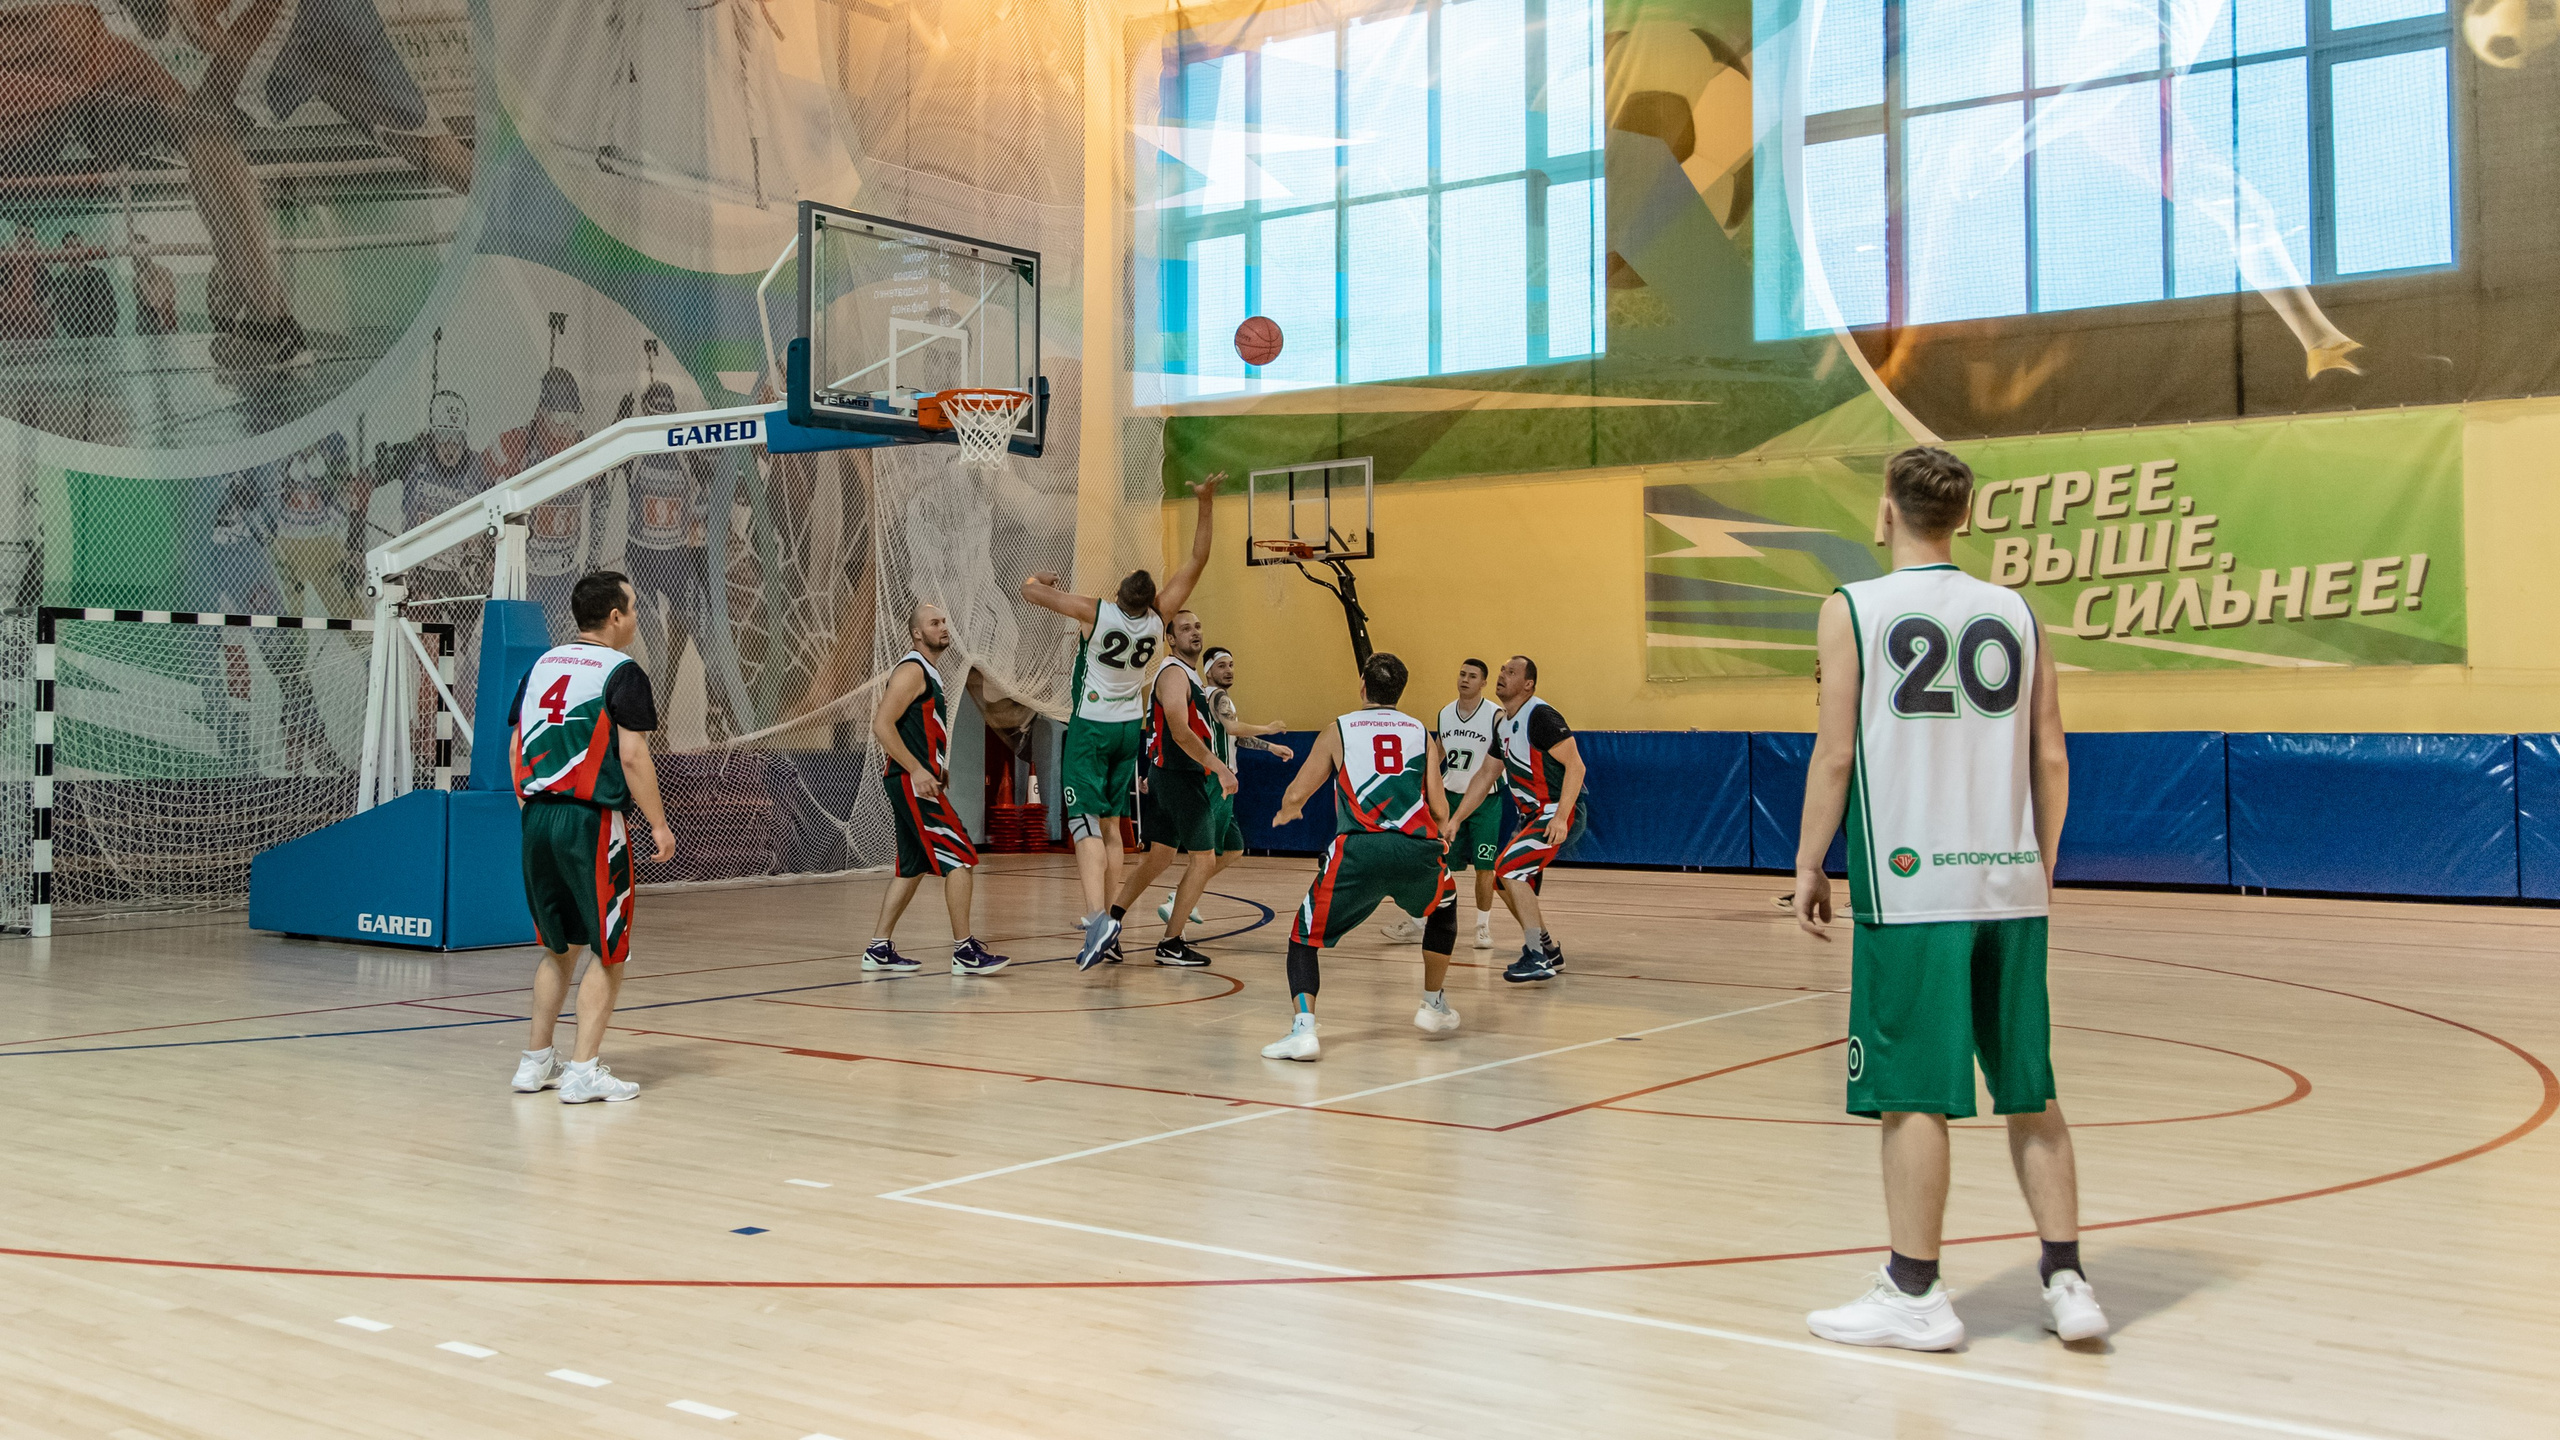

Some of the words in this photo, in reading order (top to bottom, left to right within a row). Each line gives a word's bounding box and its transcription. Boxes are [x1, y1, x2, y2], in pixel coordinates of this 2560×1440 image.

[838, 396, 869, 408] GARED
[667, 420, 757, 447] GARED
[1989, 514, 2236, 588] ВЫШЕ,
[2073, 553, 2431, 641] СИЛЬНЕЕ!
[1097, 629, 1157, 671] 28
[1884, 613, 2023, 719] 20
[539, 674, 572, 724] 4
[1454, 729, 1487, 743] ЯНГПУР
[1372, 733, 1404, 775] 8
[1447, 748, 1475, 772] 27
[1478, 844, 1497, 861] 27
[358, 912, 432, 938] GARED
